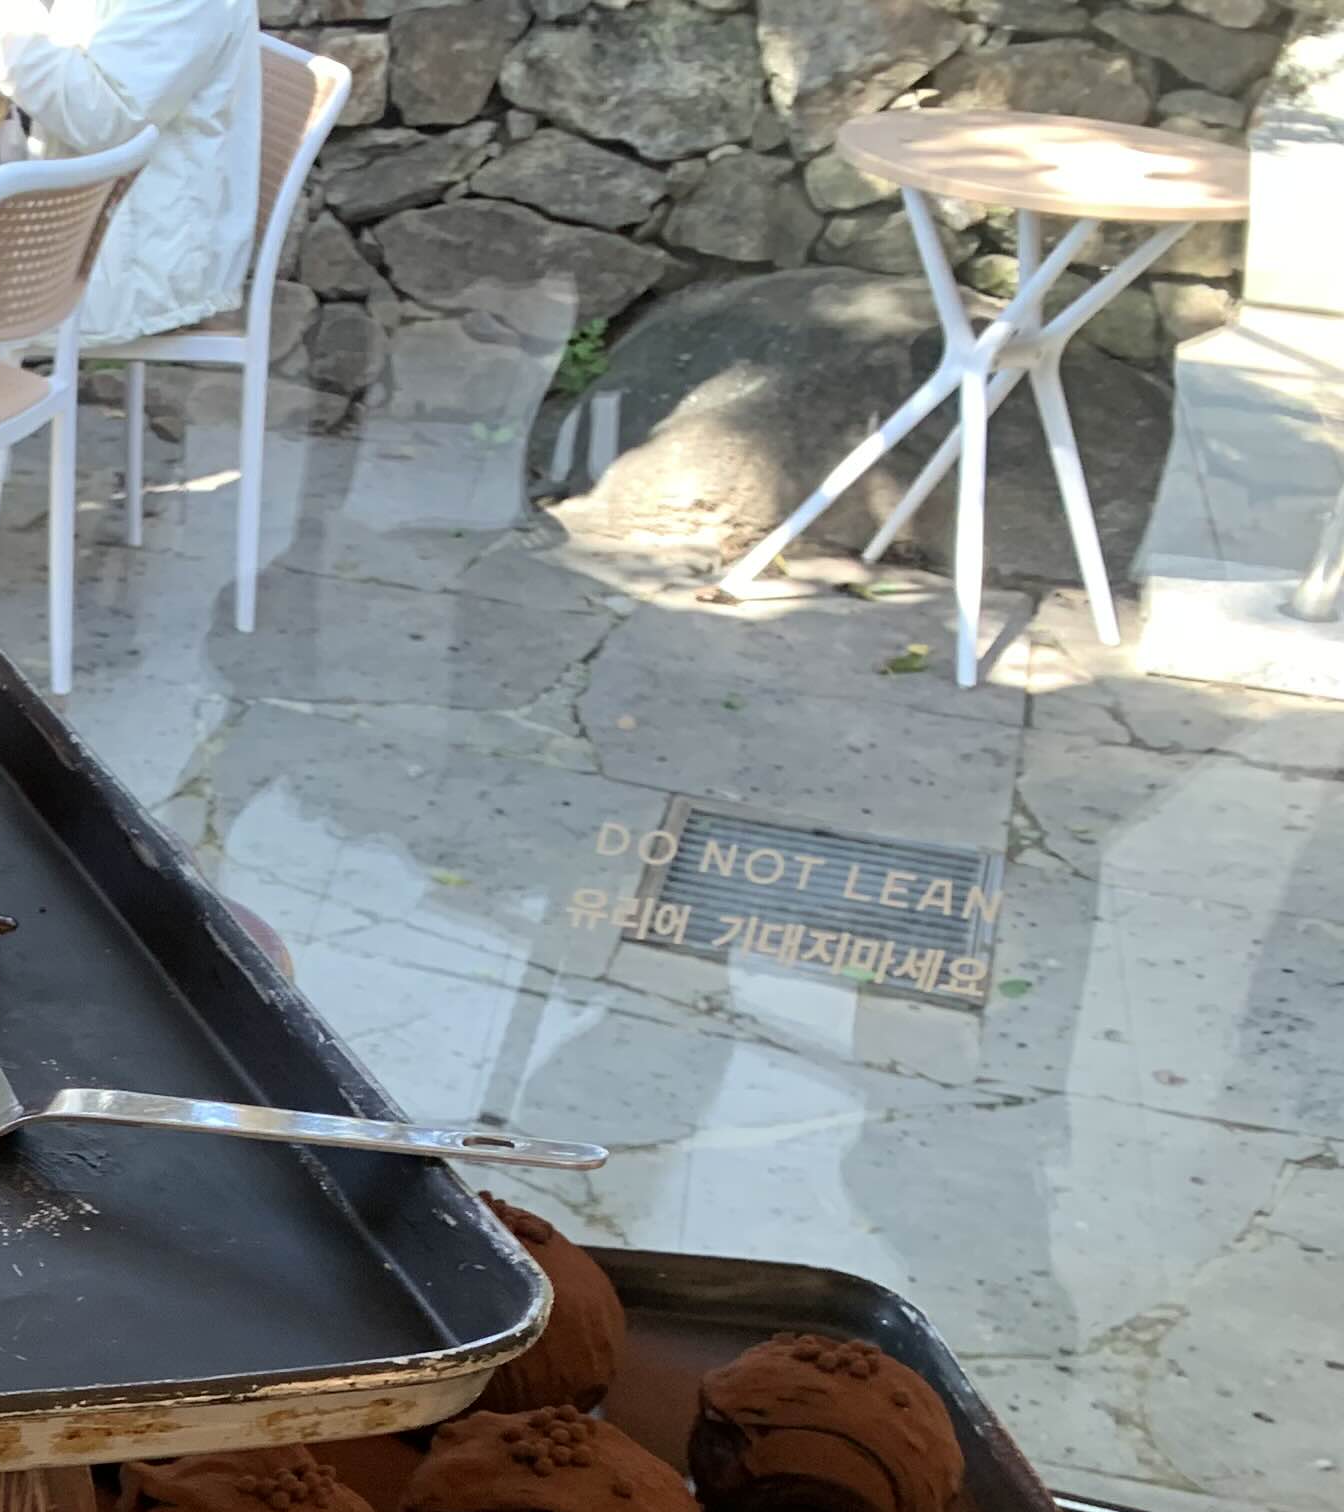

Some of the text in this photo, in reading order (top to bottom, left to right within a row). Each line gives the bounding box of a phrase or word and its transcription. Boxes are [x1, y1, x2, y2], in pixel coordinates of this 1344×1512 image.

[595, 821, 1006, 924] DO NOT LEAN
[710, 914, 989, 997] 기대지마세요
